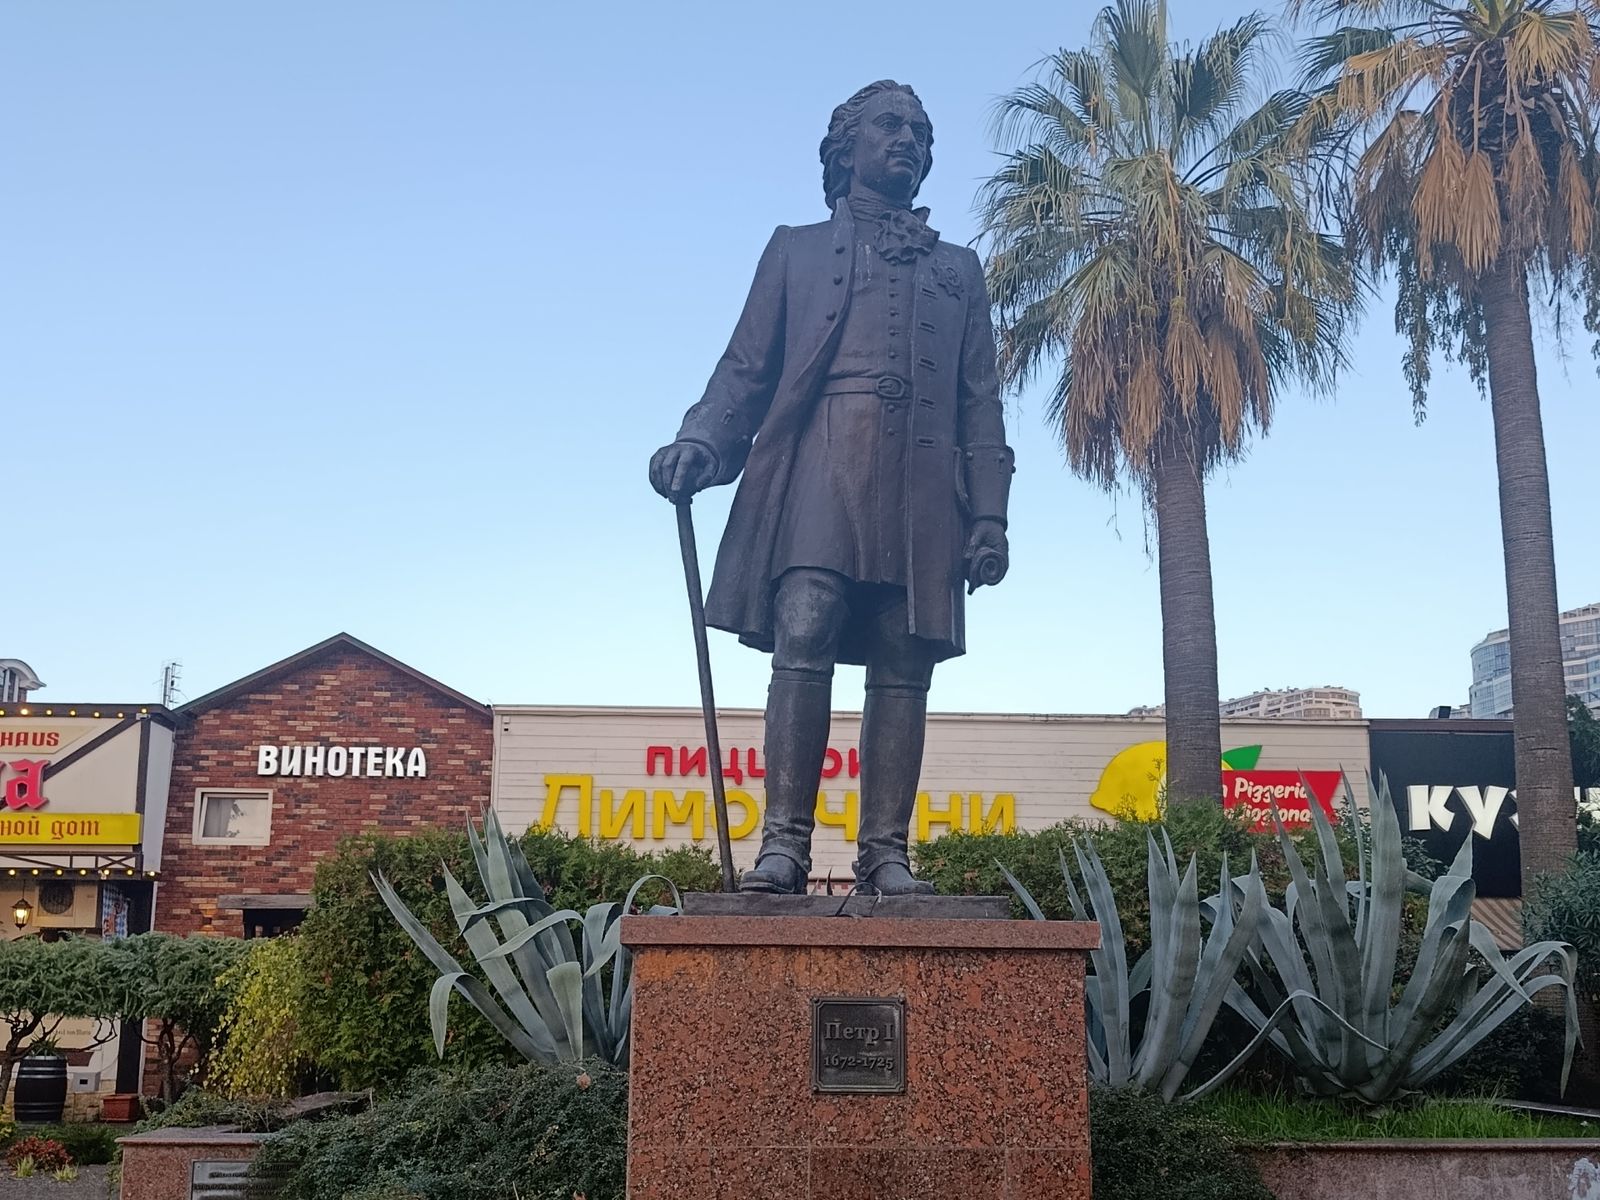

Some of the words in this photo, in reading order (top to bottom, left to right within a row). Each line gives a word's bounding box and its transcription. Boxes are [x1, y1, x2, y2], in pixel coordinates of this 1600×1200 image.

[257, 745, 427, 777] ВИНОТЕКА
[533, 774, 1015, 843] Лимочни
[824, 1021, 880, 1047] Петр
[884, 1023, 895, 1041] I
[824, 1054, 894, 1070] 1672-1725
